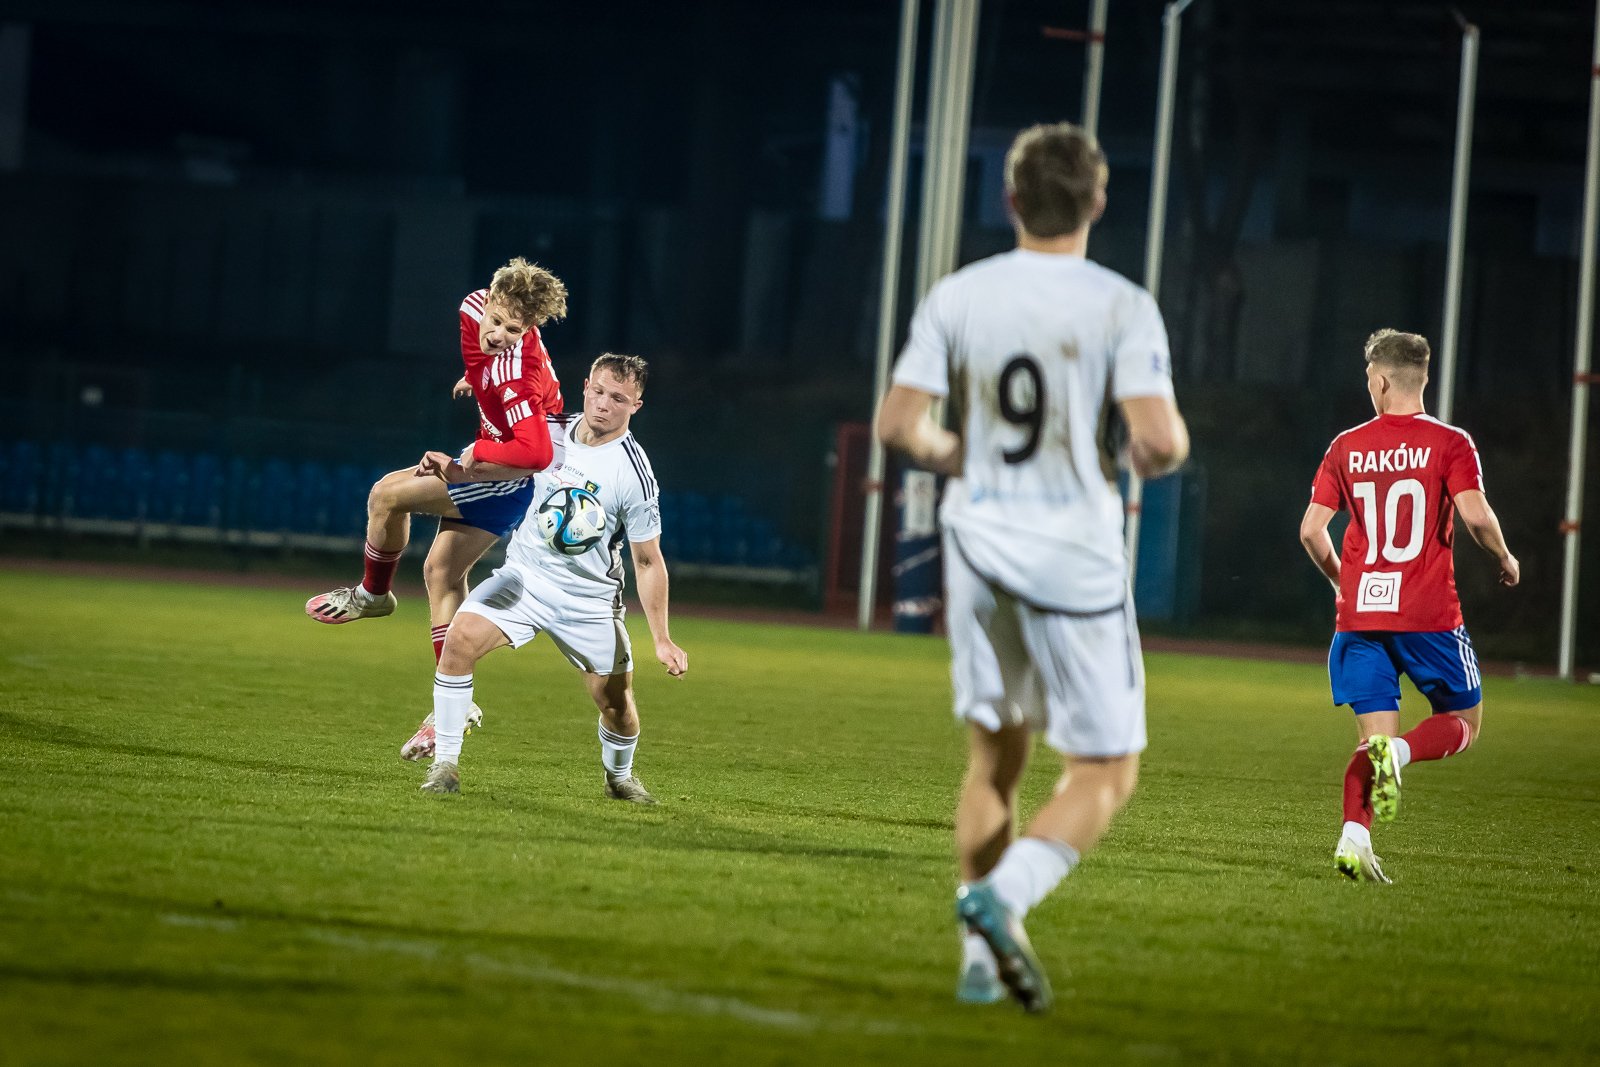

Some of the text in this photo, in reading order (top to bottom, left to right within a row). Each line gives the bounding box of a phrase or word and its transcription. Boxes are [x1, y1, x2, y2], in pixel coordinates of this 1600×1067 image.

[1000, 355, 1046, 464] 9
[564, 464, 585, 478] VOTUM
[1349, 442, 1431, 473] RAKÓW
[1353, 478, 1426, 565] 10
